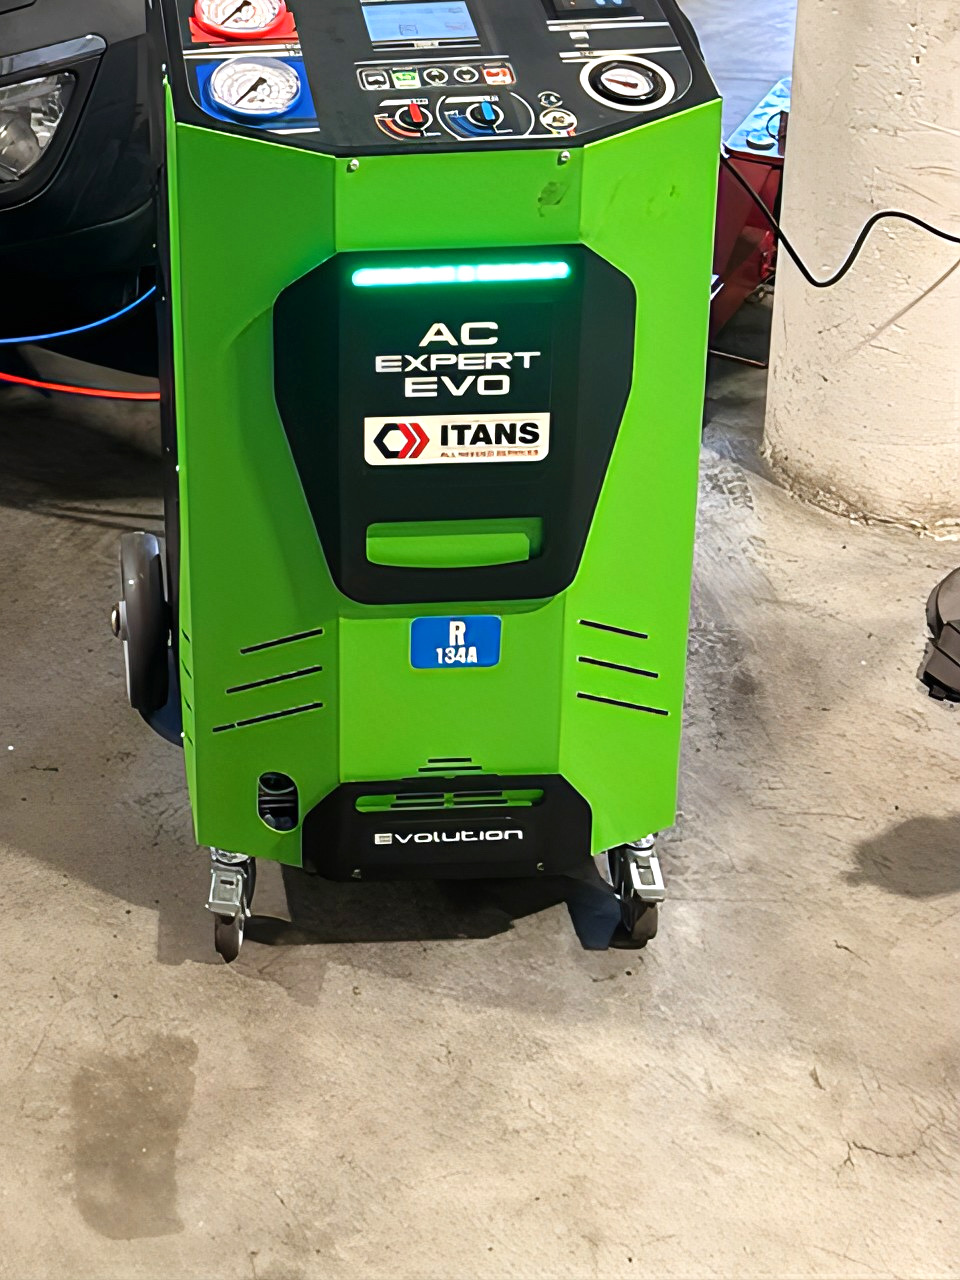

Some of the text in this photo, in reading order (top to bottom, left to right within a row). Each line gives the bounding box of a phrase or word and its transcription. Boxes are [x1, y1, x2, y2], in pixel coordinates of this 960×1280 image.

[418, 321, 499, 347] AC
[375, 351, 541, 373] EXPERT
[404, 374, 511, 398] EVO
[440, 422, 540, 446] ITANS
[449, 620, 466, 646] R
[436, 646, 478, 664] 134A
[374, 829, 524, 845] Evolution
